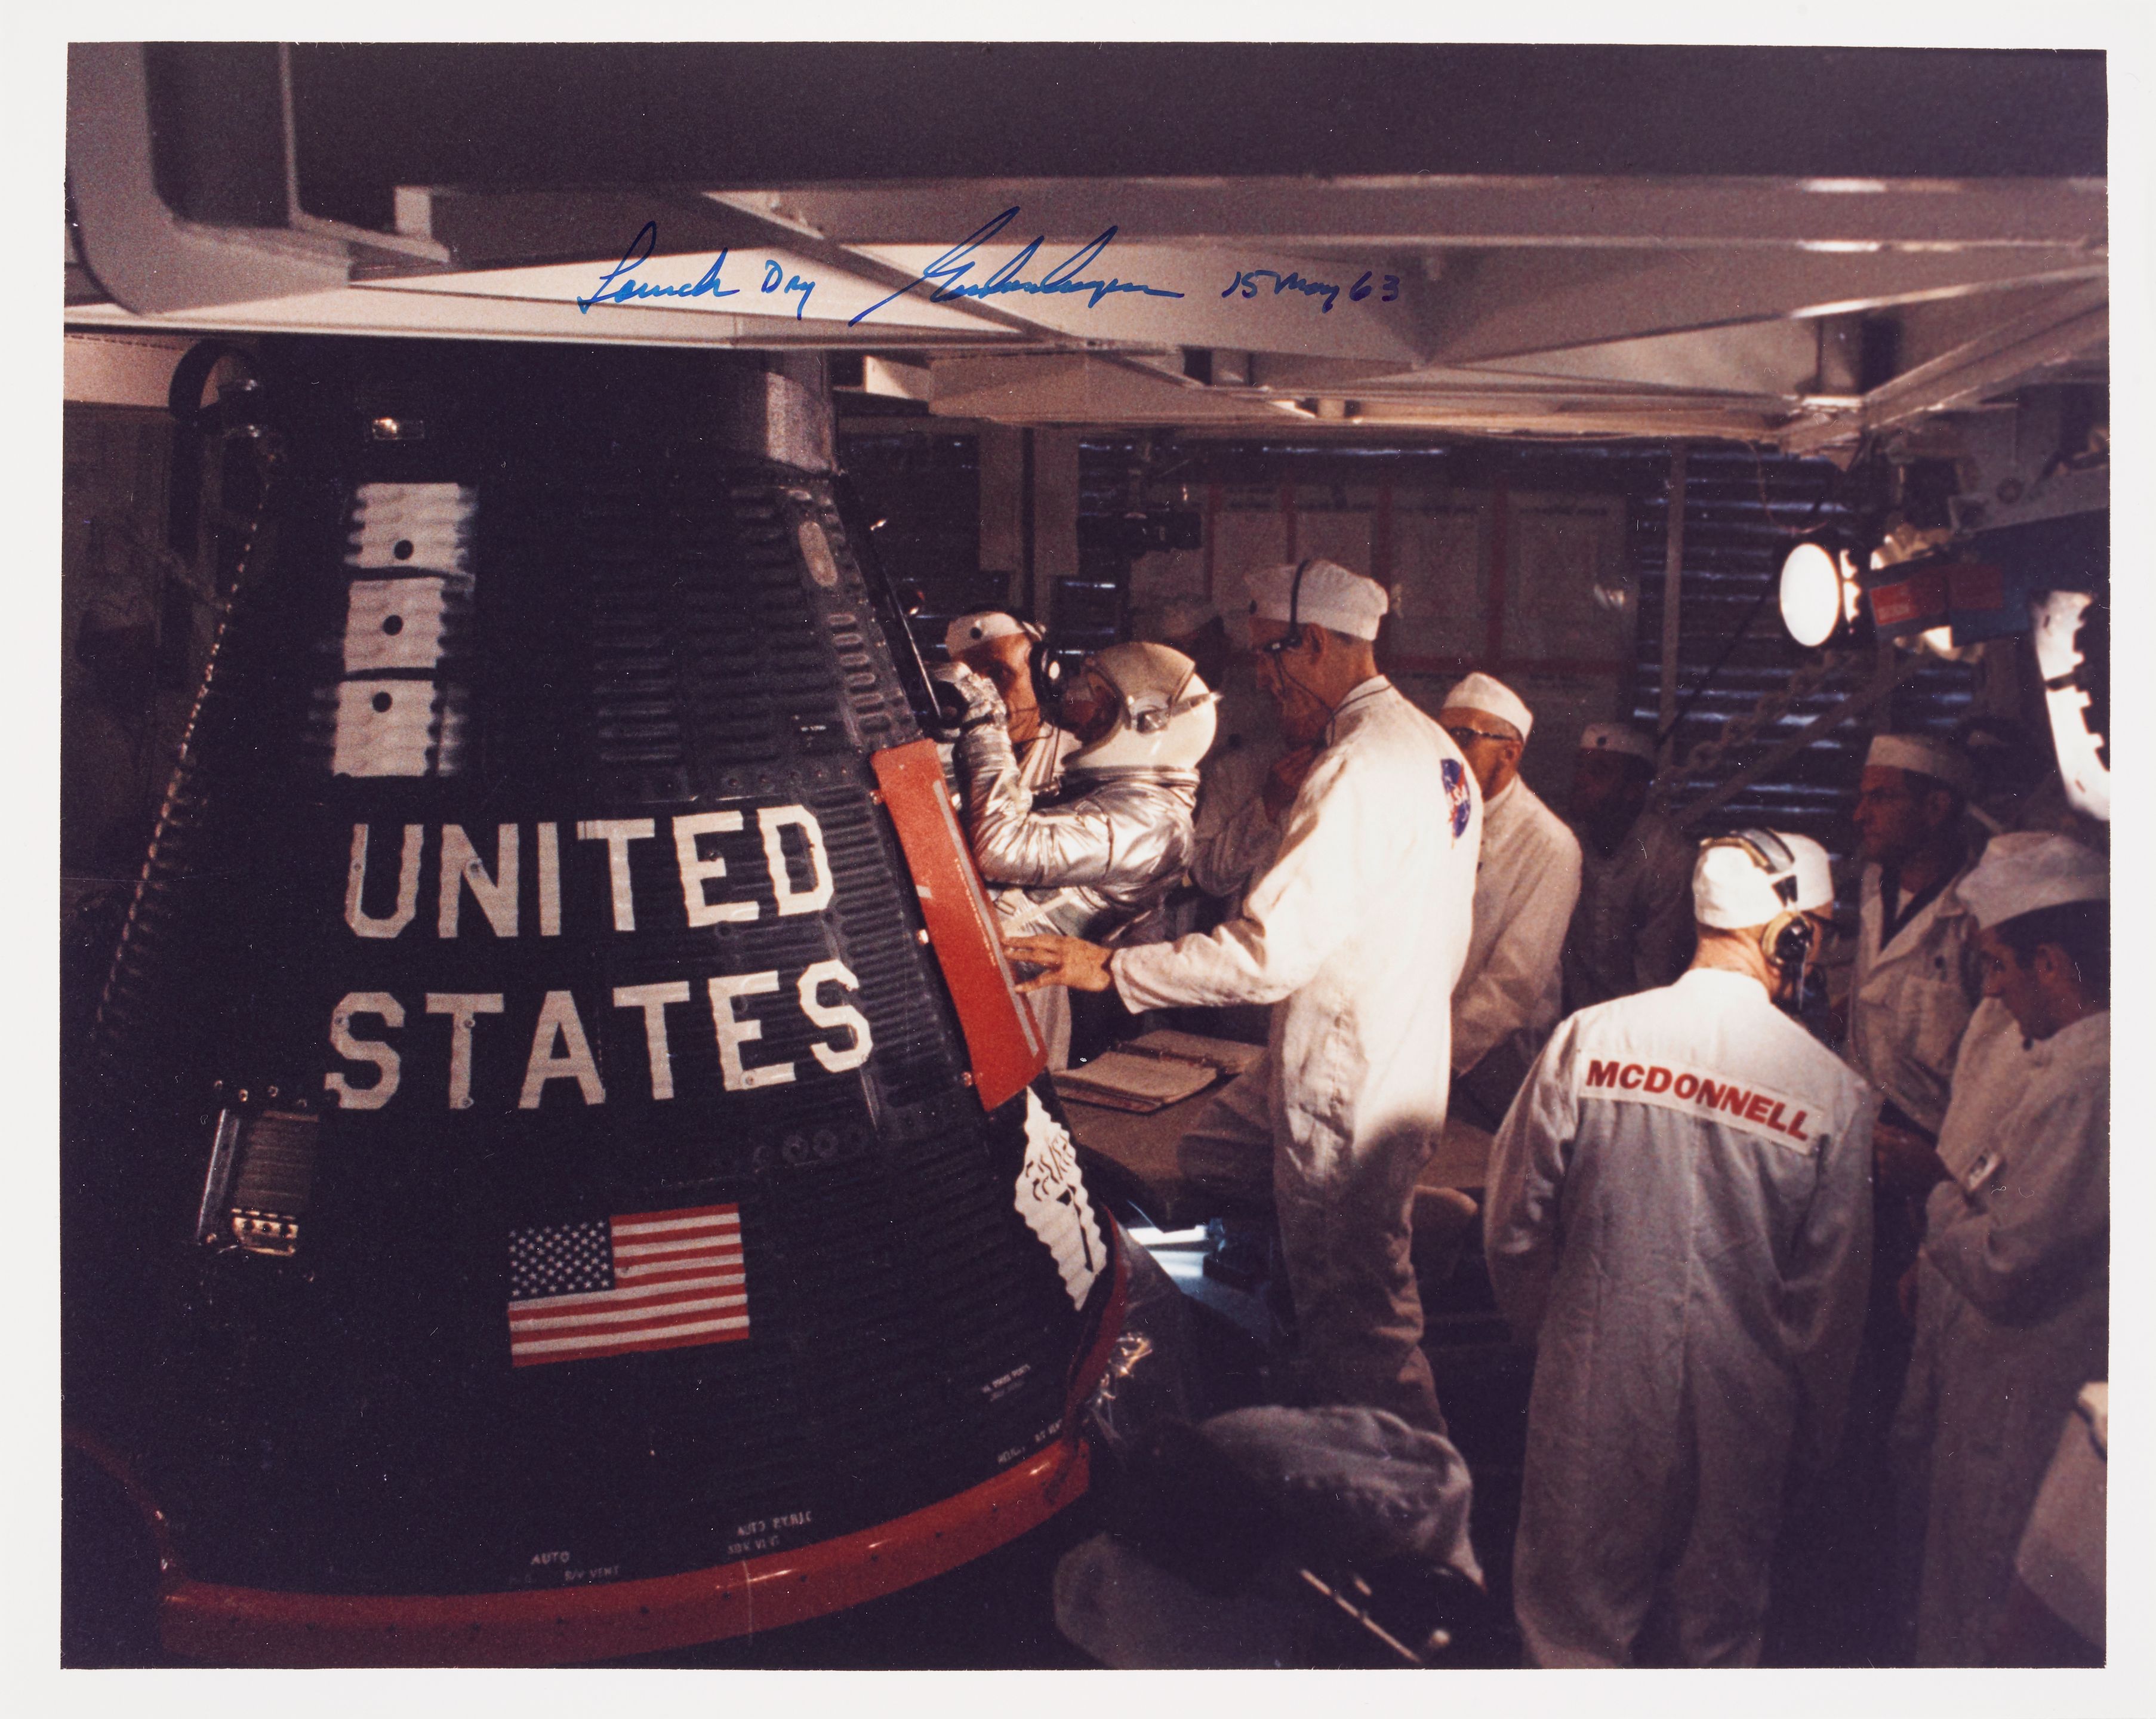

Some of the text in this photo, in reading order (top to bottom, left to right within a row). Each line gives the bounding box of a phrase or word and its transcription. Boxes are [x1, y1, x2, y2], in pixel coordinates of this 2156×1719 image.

[577, 221, 740, 314] Launch
[760, 259, 816, 321] Day
[1222, 269, 1279, 299] 15
[1274, 272, 1339, 313] May
[1349, 272, 1400, 302] 63
[344, 804, 835, 939] UNITED
[324, 959, 873, 1110] STATES
[1585, 1059, 1809, 1141] MCDONNELL
[530, 1551, 570, 1565] AUTO
